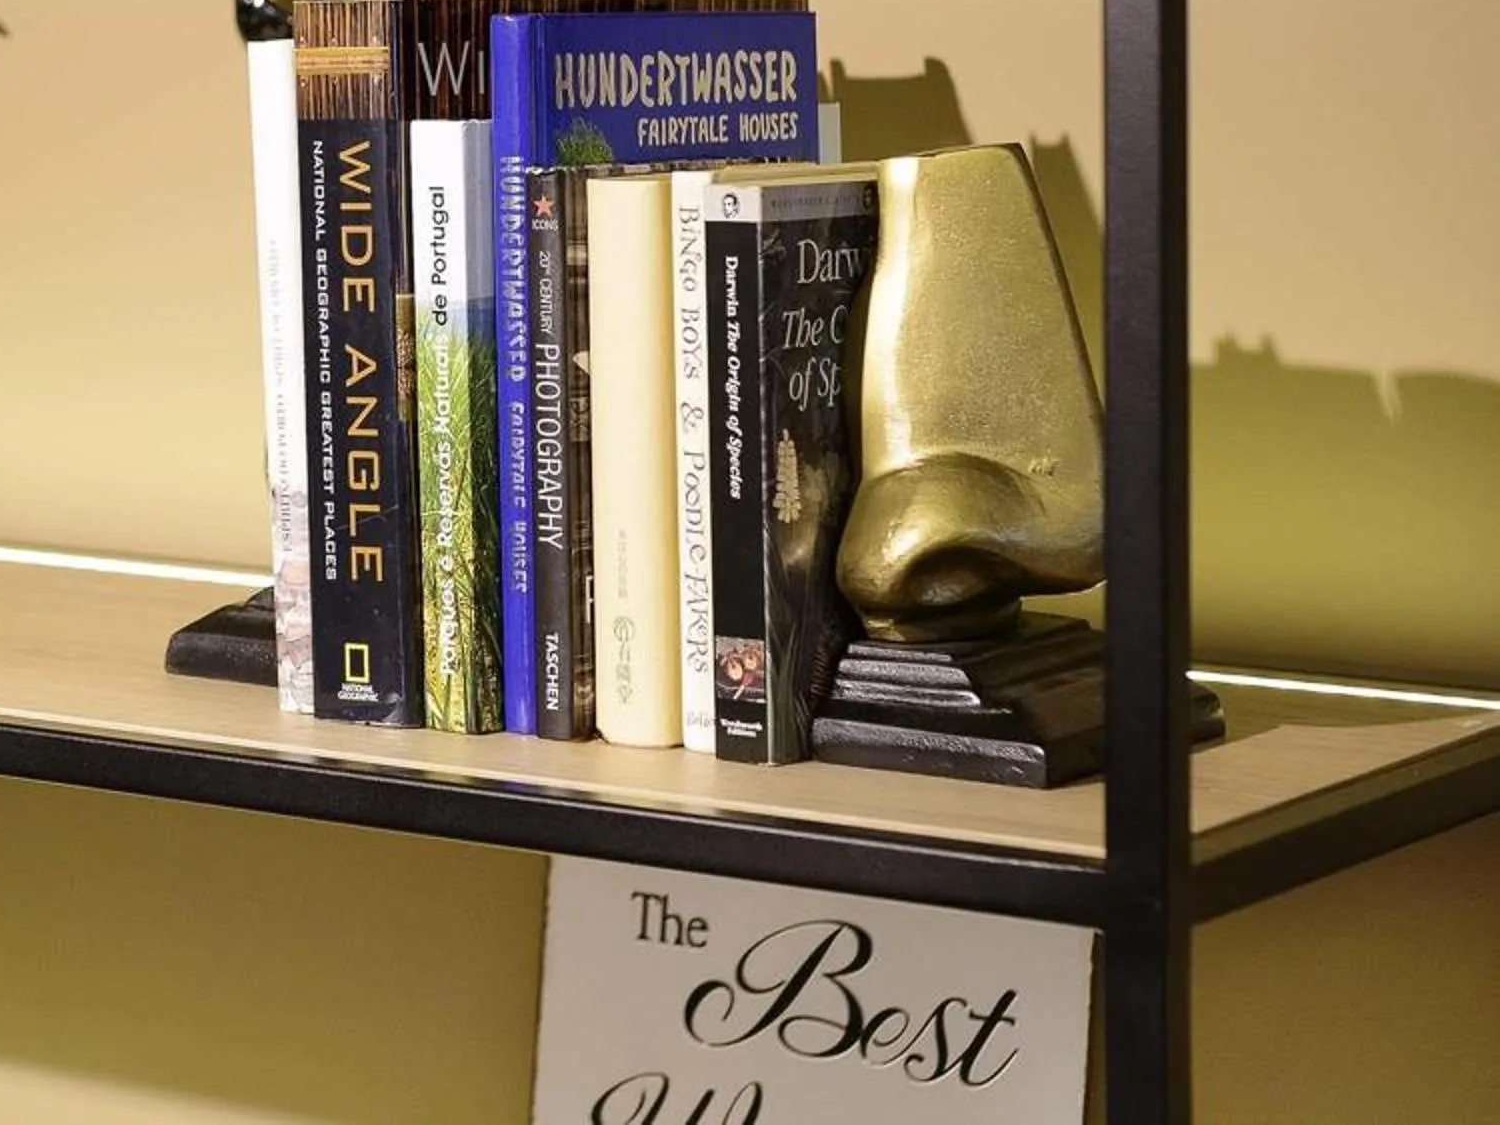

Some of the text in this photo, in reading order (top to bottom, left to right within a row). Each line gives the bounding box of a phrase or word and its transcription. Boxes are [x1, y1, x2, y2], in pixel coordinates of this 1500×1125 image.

[418, 41, 485, 97] WI
[554, 50, 798, 110] HUNDERTWASSER
[637, 112, 799, 147] FAIRYTALE HOUSES
[428, 186, 450, 286] Portugal
[532, 218, 559, 232] ICONS
[797, 239, 864, 285] Darw
[500, 155, 528, 383] HUNDERTWASSER
[539, 278, 553, 335] CENTURY
[433, 294, 448, 327] de
[681, 307, 704, 380] BOYS
[782, 306, 824, 350] The
[313, 140, 337, 581] NATIONAL GEOGRAPHIC GREATEST PLACES
[339, 140, 384, 582] WIDE ANGLE
[433, 334, 450, 435] Naturais
[725, 255, 743, 500] Darwin The Origin of Species
[789, 357, 817, 412] of
[535, 344, 564, 551] PHOTOGRAPHY
[680, 401, 704, 429] &
[511, 400, 526, 509] FAIRYTALE
[436, 441, 454, 548] Reservas
[440, 578, 460, 676] Parques
[545, 632, 560, 711] TASCHEN
[630, 891, 710, 949] The
[683, 919, 1019, 1088] Best
